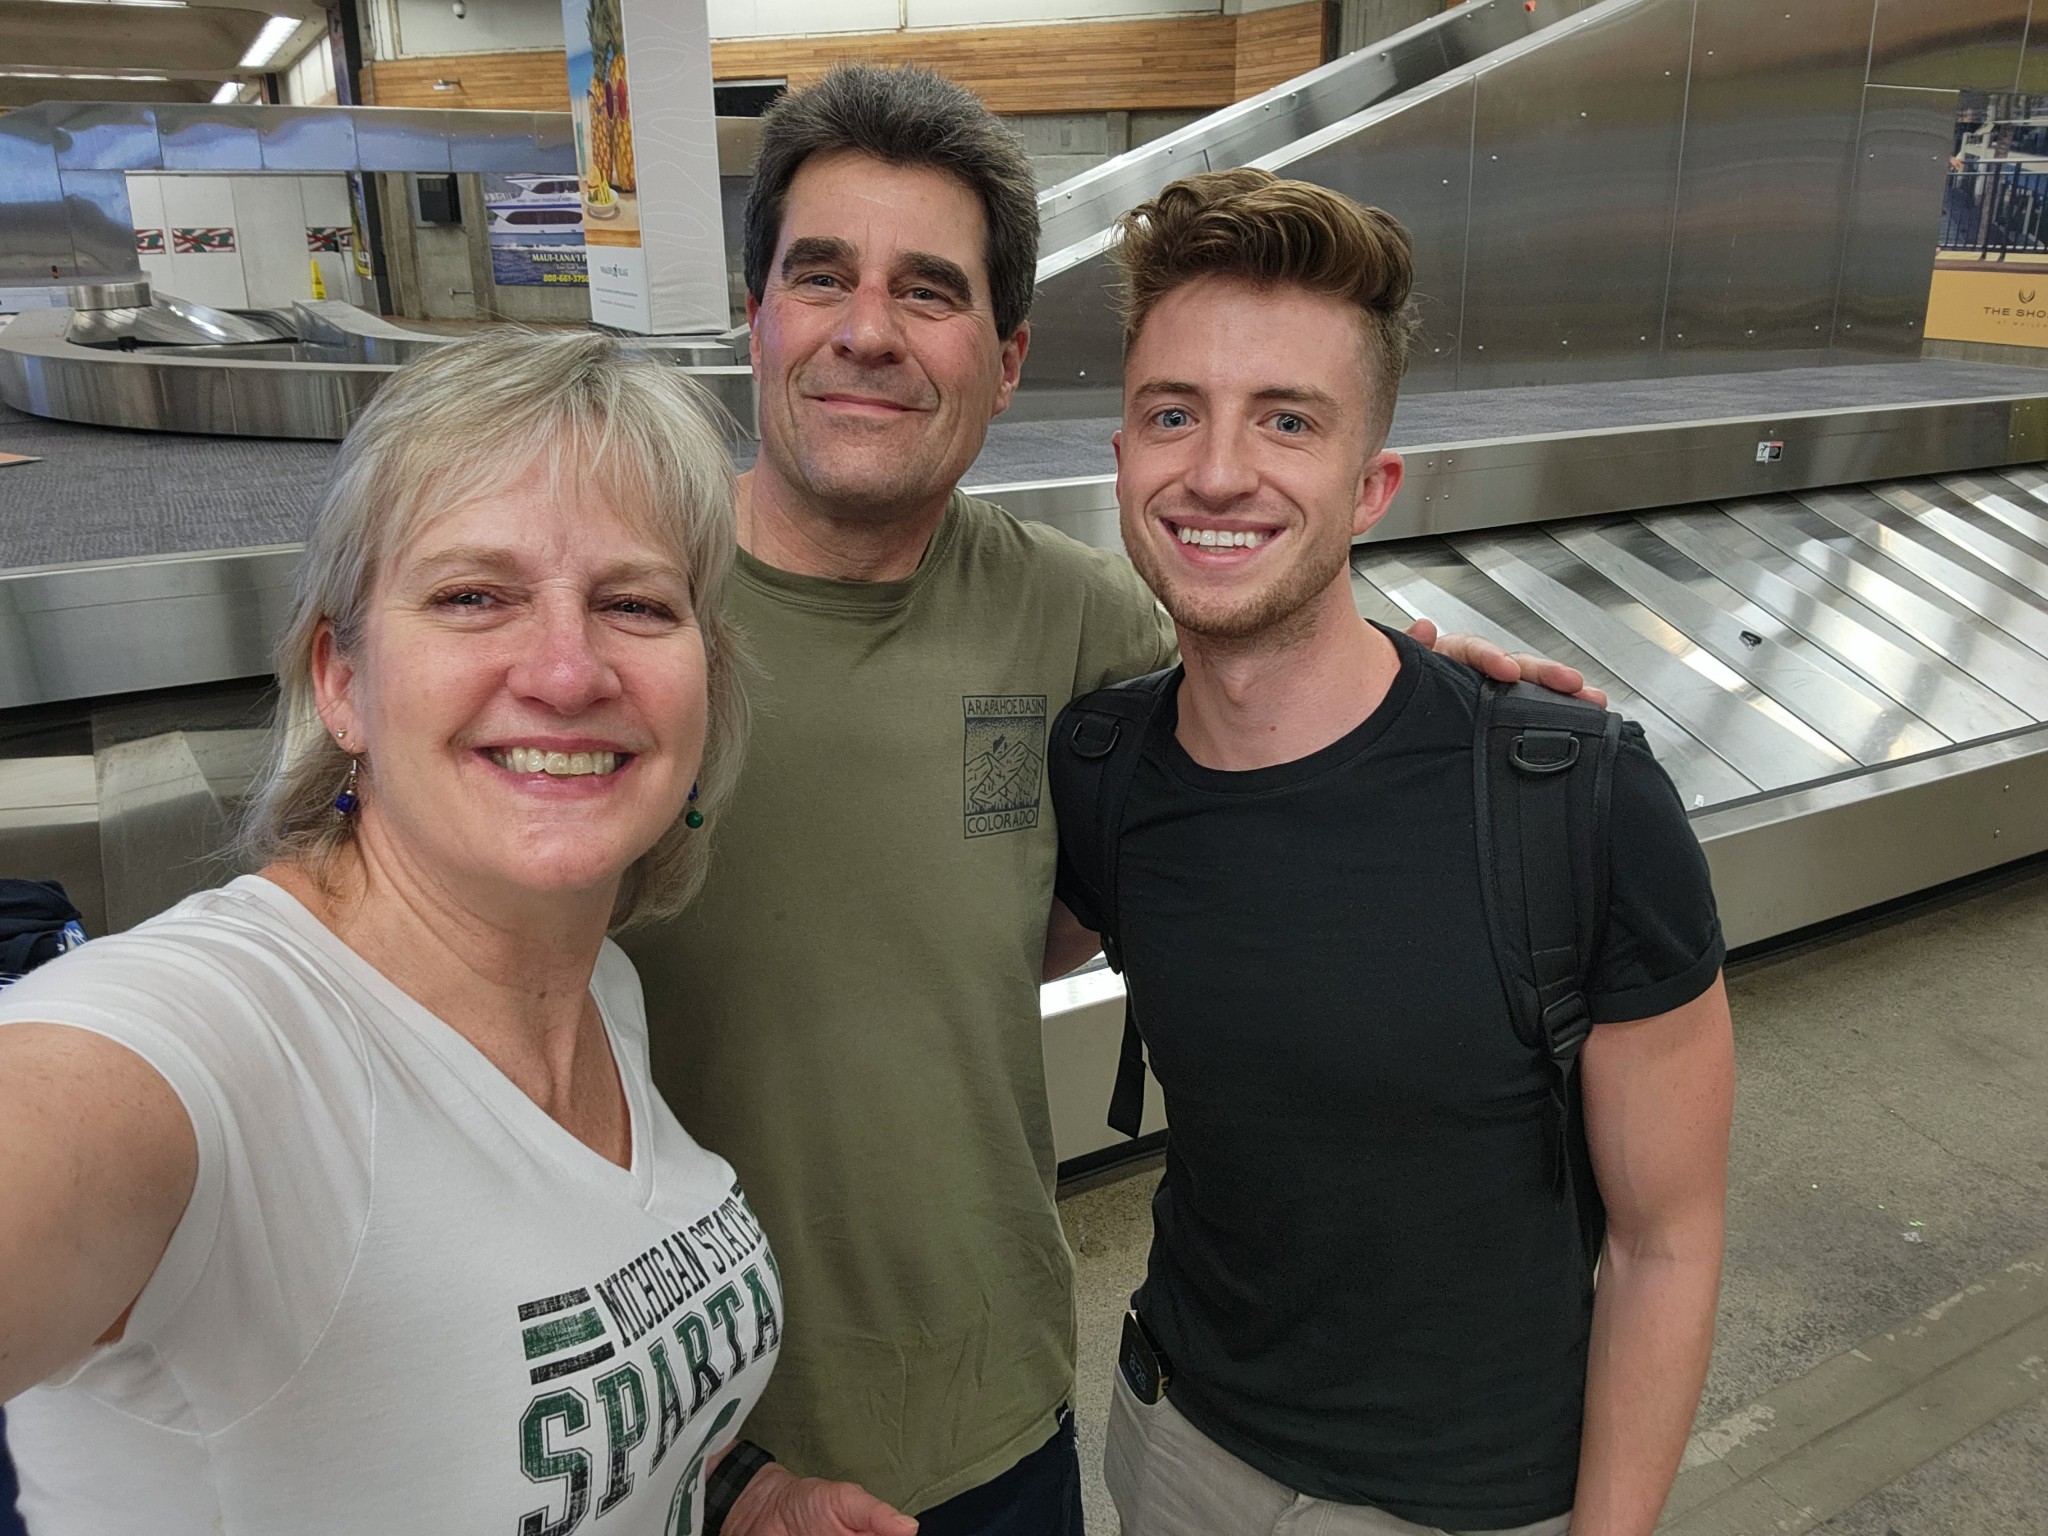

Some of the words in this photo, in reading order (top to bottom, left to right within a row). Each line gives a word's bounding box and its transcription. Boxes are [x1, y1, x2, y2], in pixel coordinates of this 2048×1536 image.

[1983, 306, 2011, 316] THE
[967, 698, 1018, 715] ARAPAHOE
[1019, 698, 1044, 714] BASIN
[967, 808, 1036, 833] COLORADO
[594, 1230, 712, 1348] MICHIGAN
[688, 1196, 763, 1275] STATE
